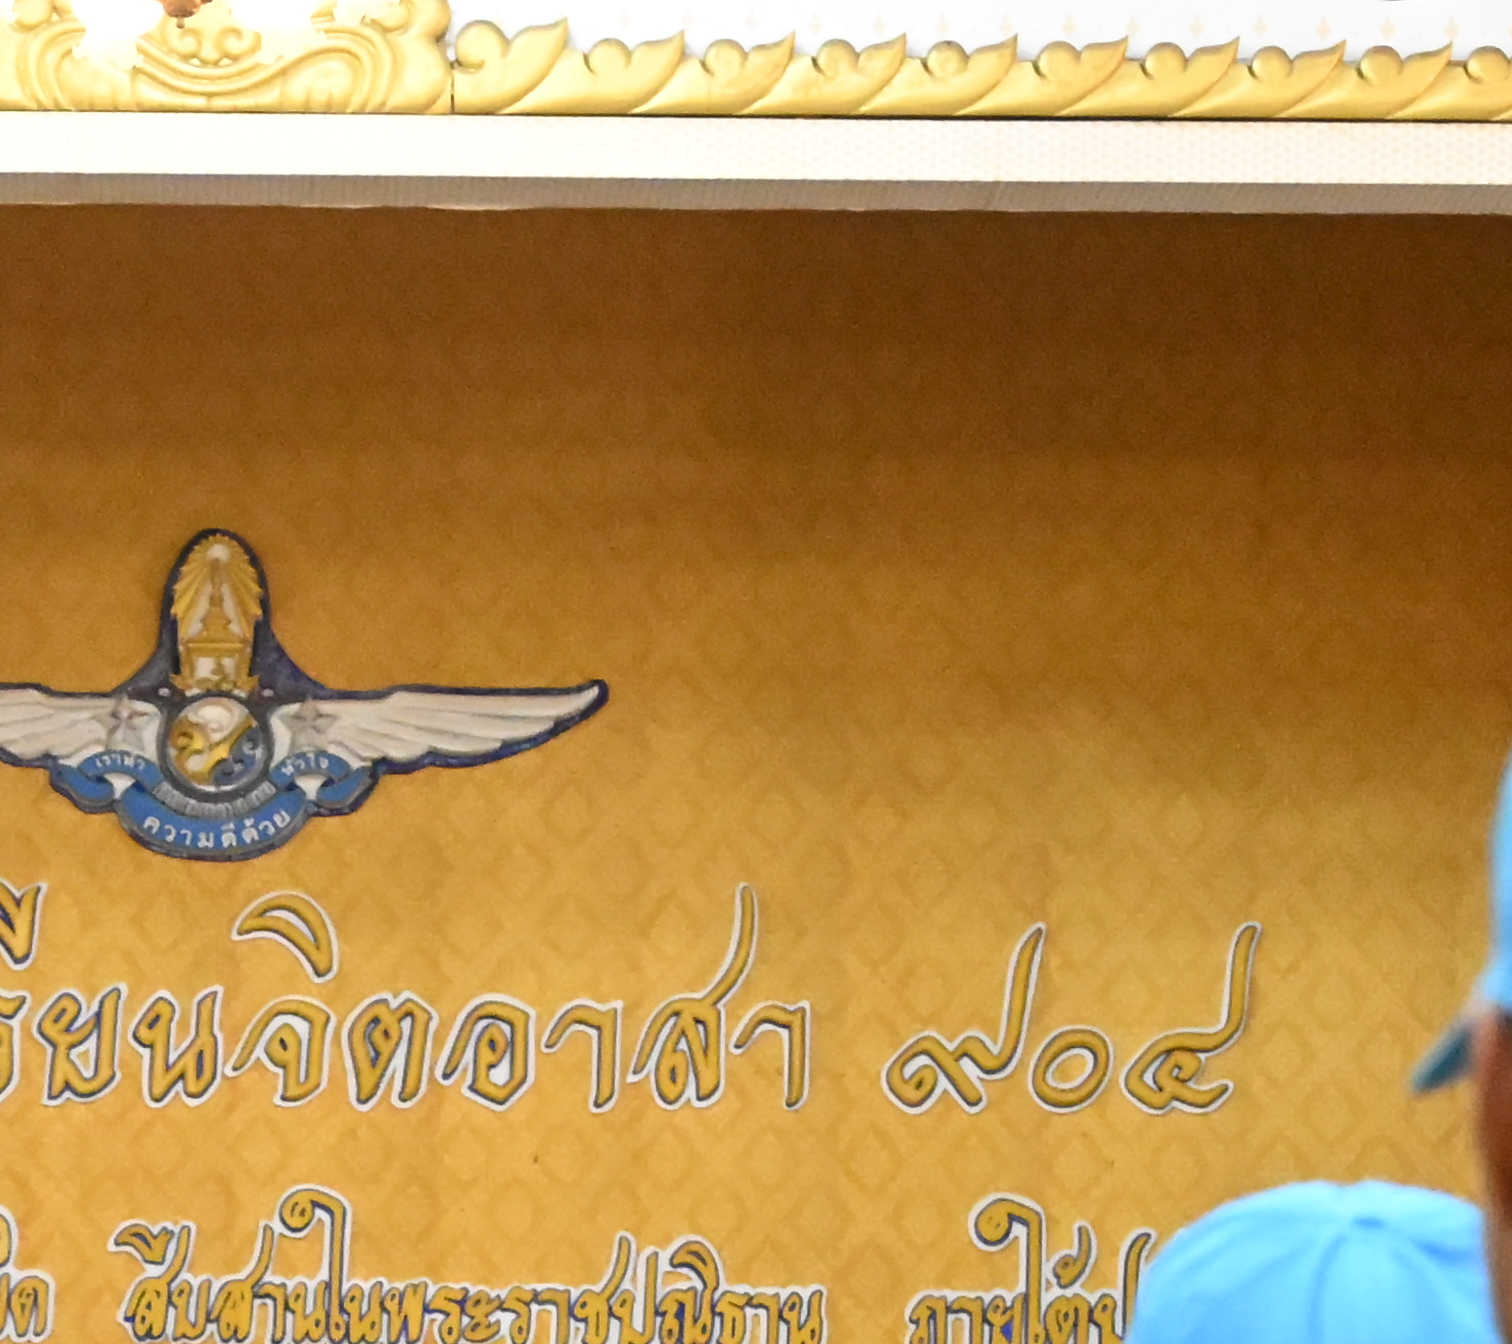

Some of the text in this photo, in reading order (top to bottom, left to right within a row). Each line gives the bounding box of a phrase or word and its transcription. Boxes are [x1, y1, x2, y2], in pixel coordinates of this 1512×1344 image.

[142, 809, 292, 849] ความดีด้วย
[882, 922, 1261, 1113] ๙๐๔
